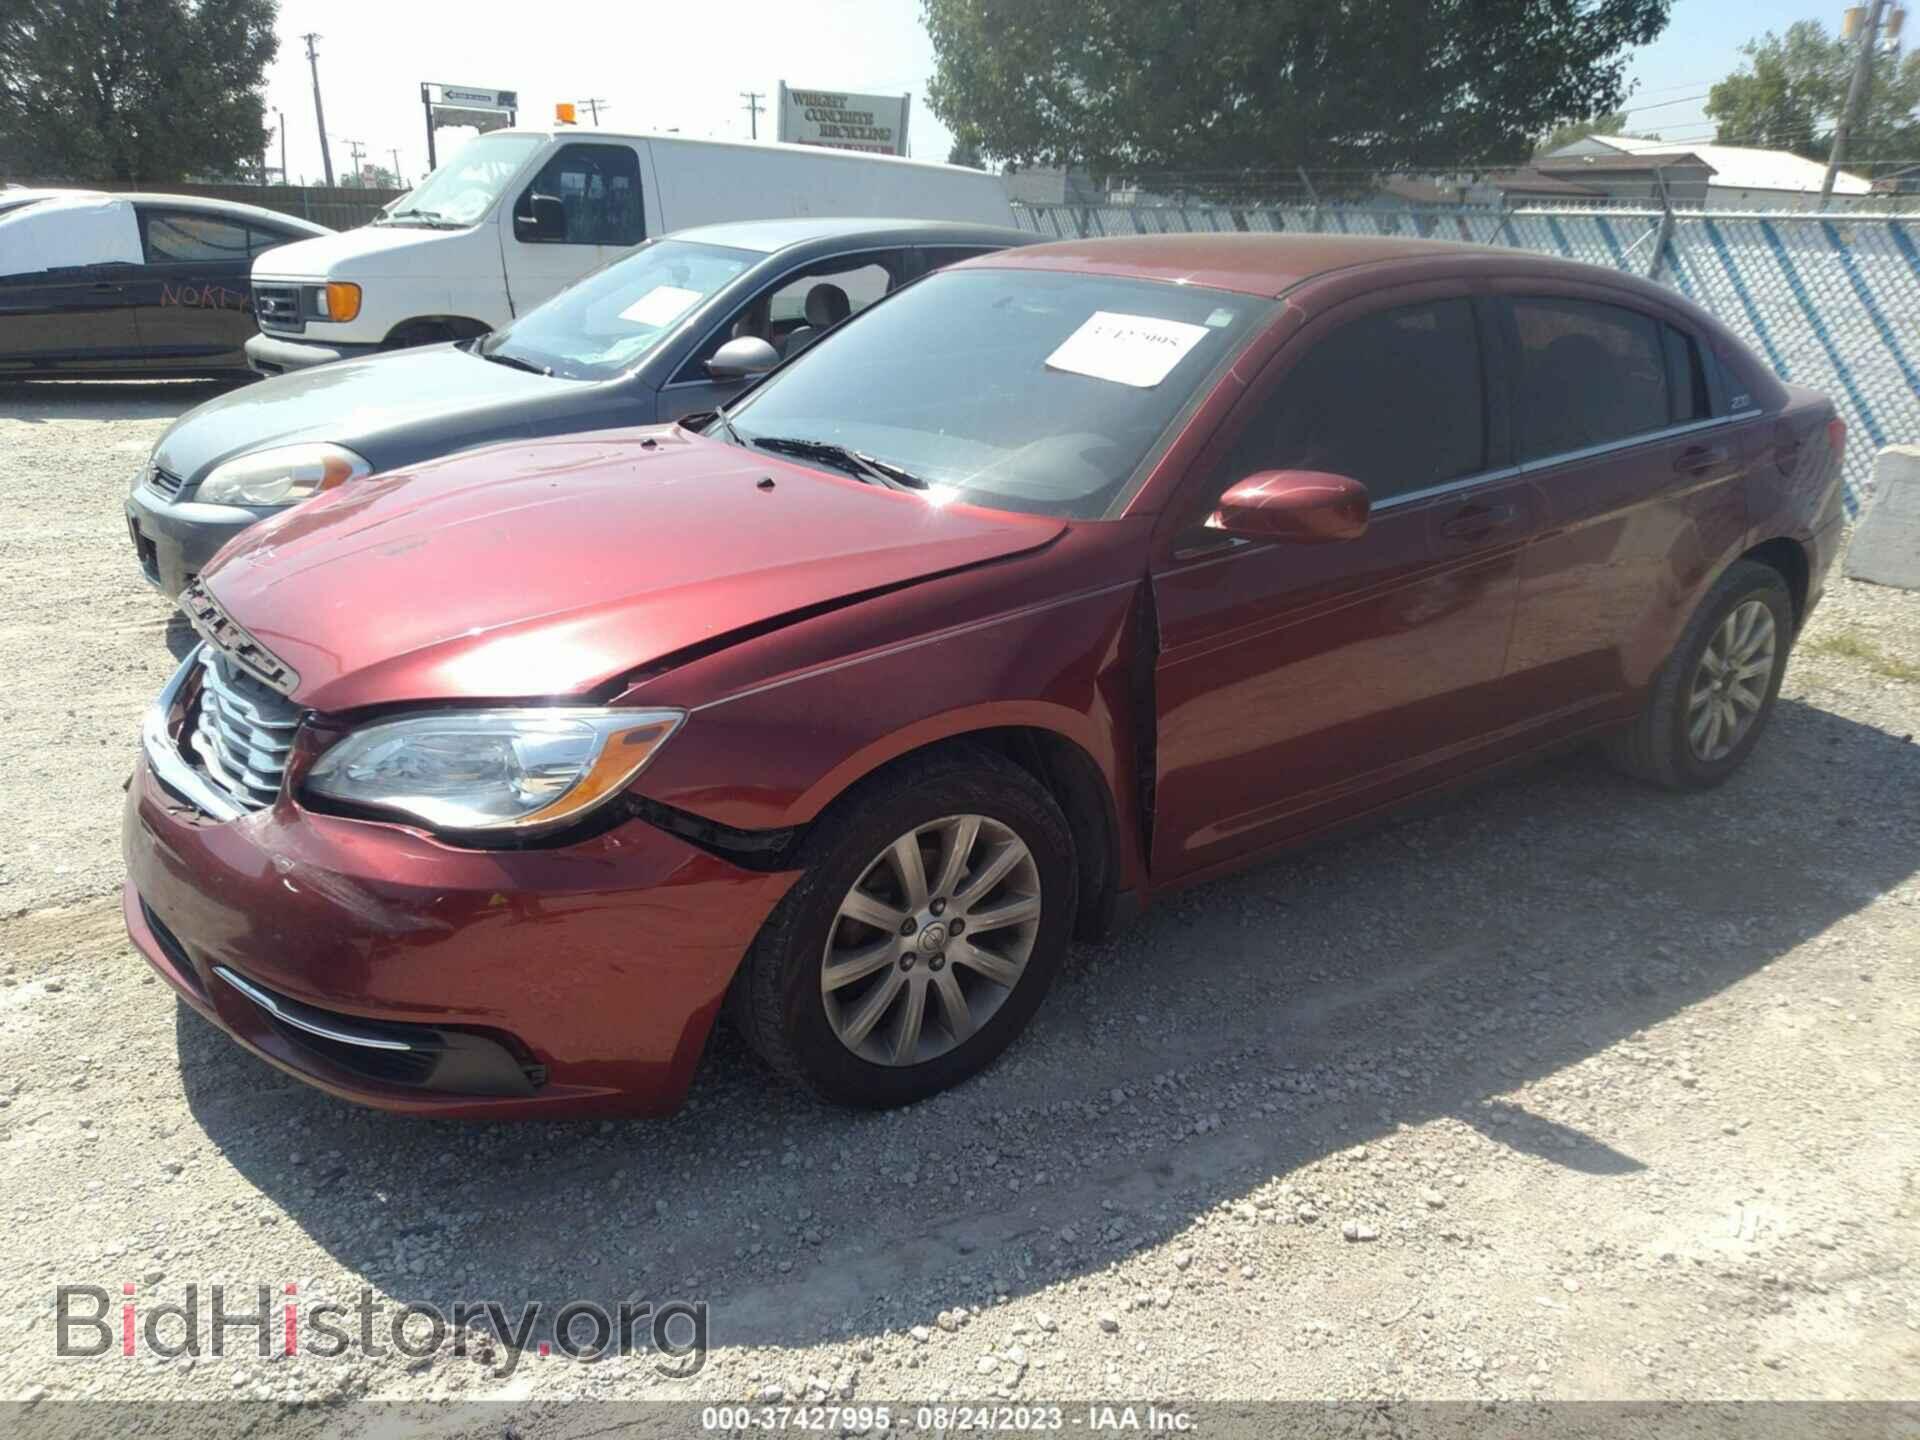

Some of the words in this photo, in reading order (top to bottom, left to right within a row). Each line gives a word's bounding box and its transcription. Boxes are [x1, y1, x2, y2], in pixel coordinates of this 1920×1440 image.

[792, 92, 848, 109] WRIGHT
[804, 108, 874, 125] CONCRETE
[818, 124, 891, 141] RECYCLING
